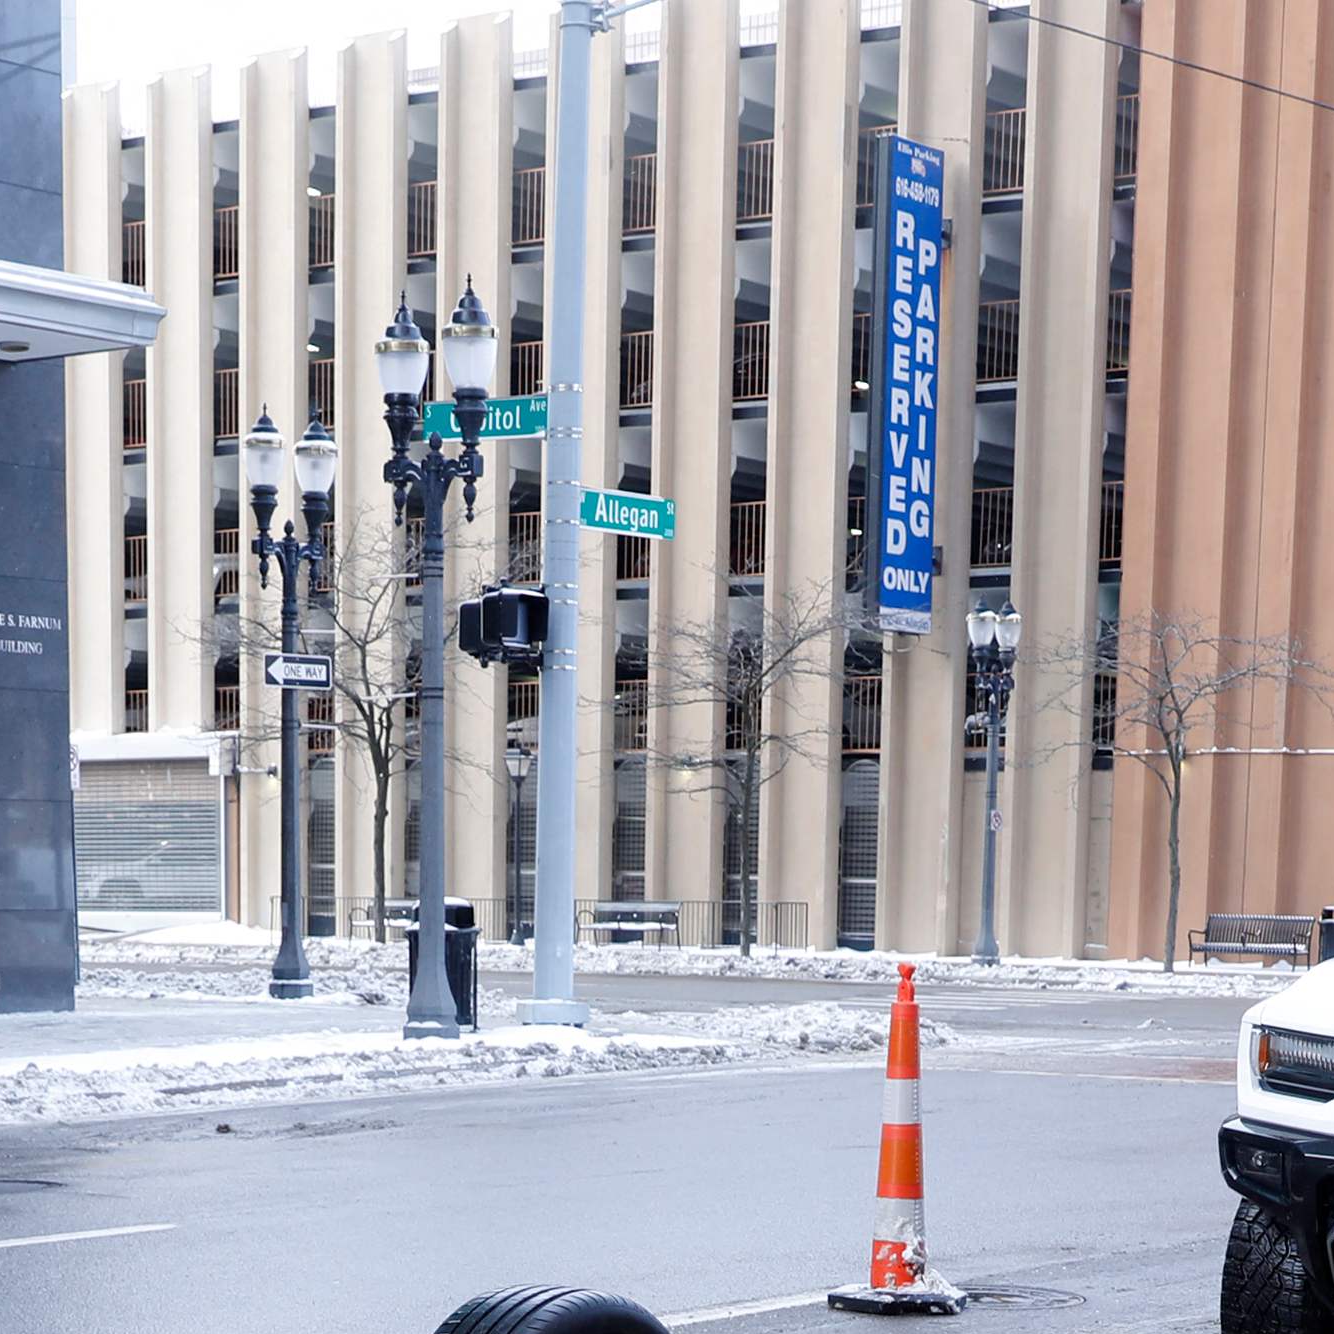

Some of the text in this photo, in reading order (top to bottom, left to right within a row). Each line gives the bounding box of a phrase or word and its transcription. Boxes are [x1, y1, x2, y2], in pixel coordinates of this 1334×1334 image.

[886, 209, 915, 555] RESERVED
[909, 238, 937, 538] PARKING
[450, 405, 522, 433] Citol
[529, 399, 547, 413] Ave
[594, 493, 659, 532] Allegan
[666, 502, 674, 515] St
[883, 566, 930, 594] ONLY
[18, 614, 62, 631] FARNUM
[283, 664, 325, 679] ONE WAY
